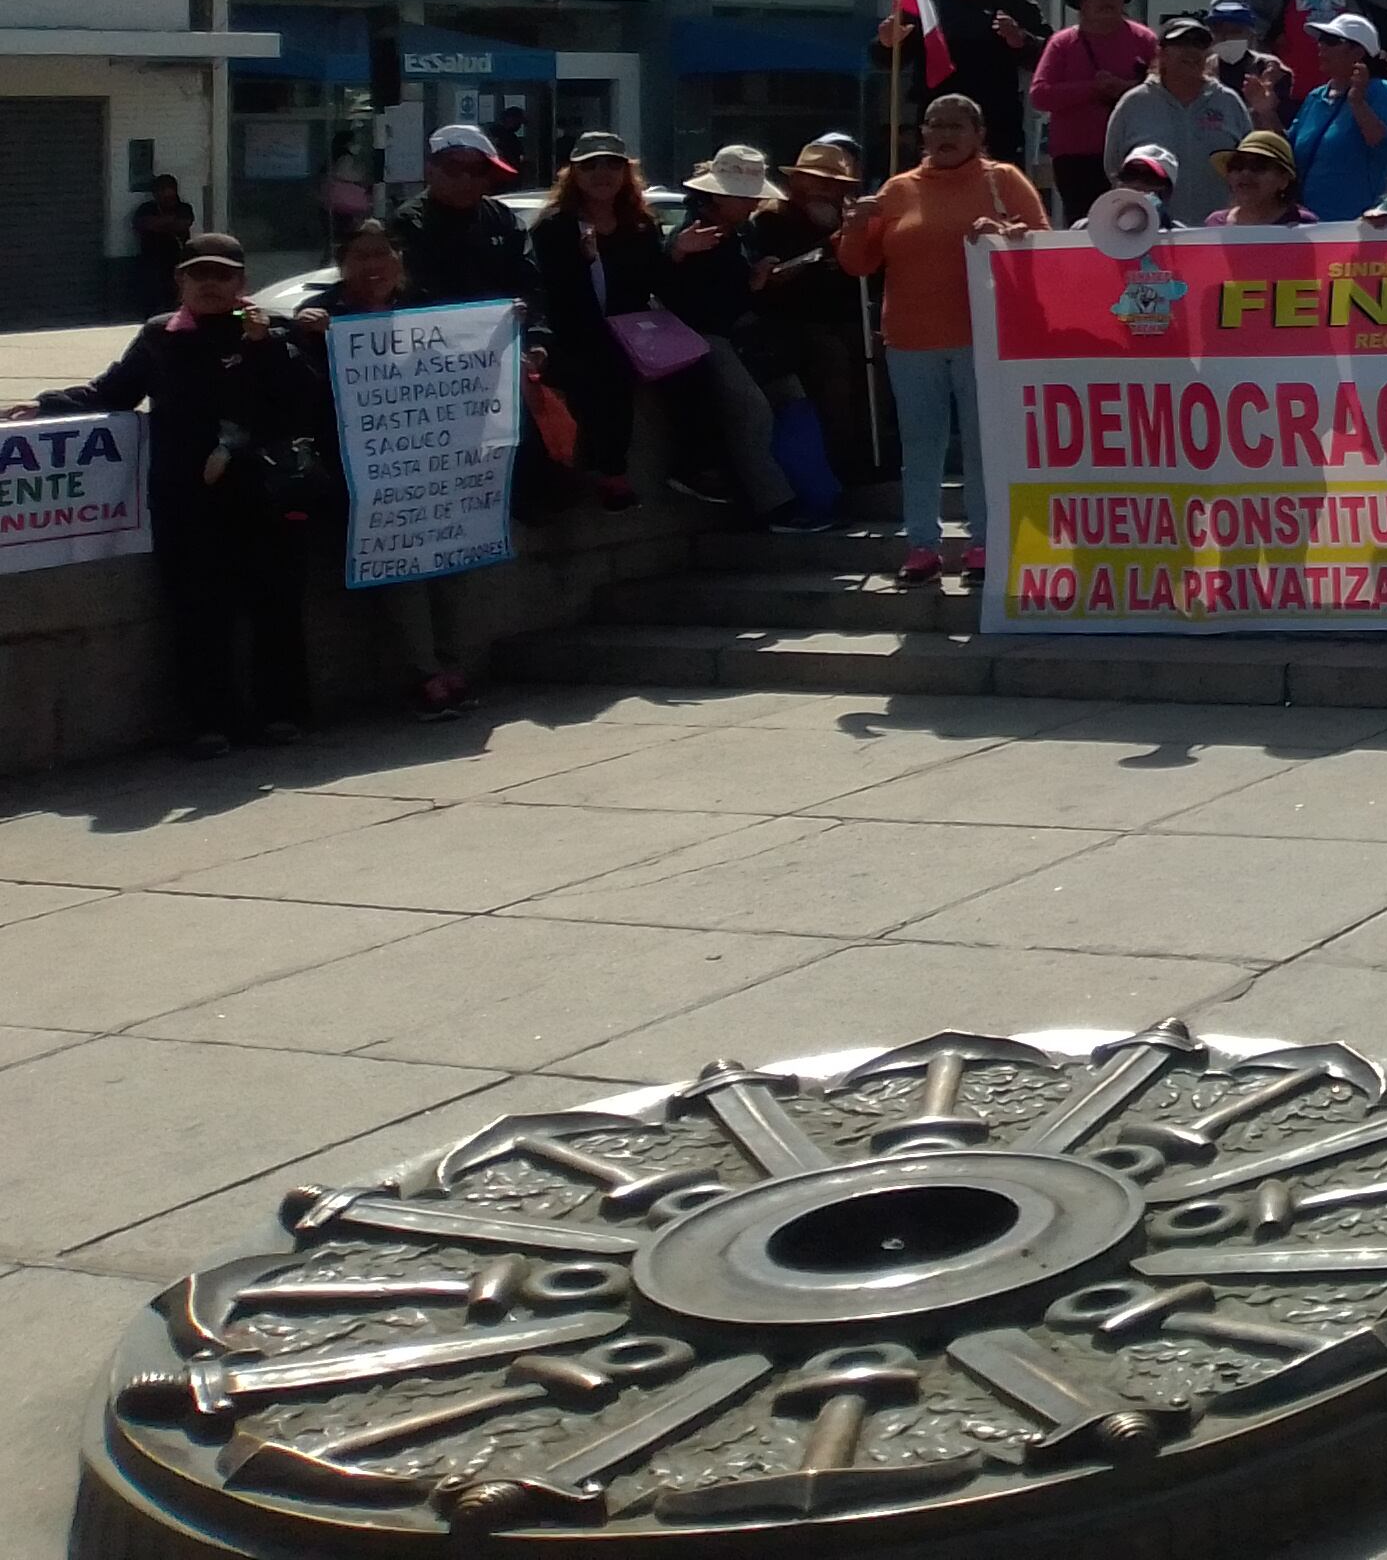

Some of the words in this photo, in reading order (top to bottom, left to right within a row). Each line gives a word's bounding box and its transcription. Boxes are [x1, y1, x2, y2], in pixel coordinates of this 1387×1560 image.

[404, 52, 493, 74] EsSalud
[349, 326, 448, 359] FUERA
[345, 362, 402, 386] DINA
[414, 351, 500, 377] ASESINA
[361, 407, 430, 432] BASTA
[436, 404, 457, 423] DE
[368, 459, 422, 481] BASTA
[429, 454, 450, 473] DE
[372, 486, 426, 506] ABUSO
[428, 480, 449, 497] DE
[368, 507, 427, 530] BASTA
[433, 502, 454, 521] DE
[1052, 495, 1178, 547] NUEVA
[1019, 567, 1077, 613] NO
[1088, 566, 1115, 612] A
[1128, 566, 1176, 612] LA
